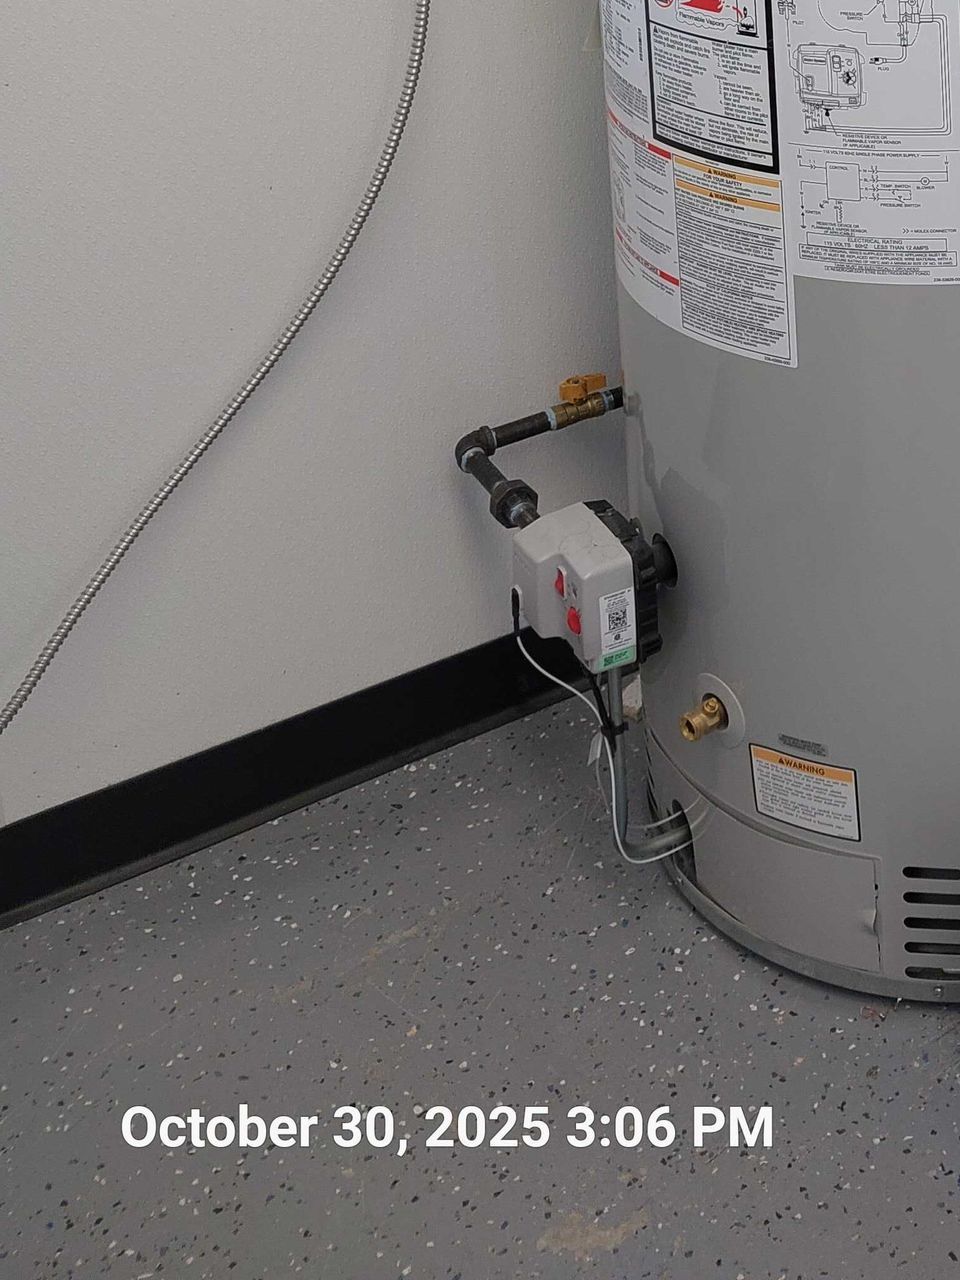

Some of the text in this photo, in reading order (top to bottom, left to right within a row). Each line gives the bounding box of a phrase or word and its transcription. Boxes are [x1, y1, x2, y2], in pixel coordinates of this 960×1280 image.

[712, 169, 736, 179] WARNING
[714, 192, 737, 203] WARNING
[785, 759, 824, 776] WARNING
